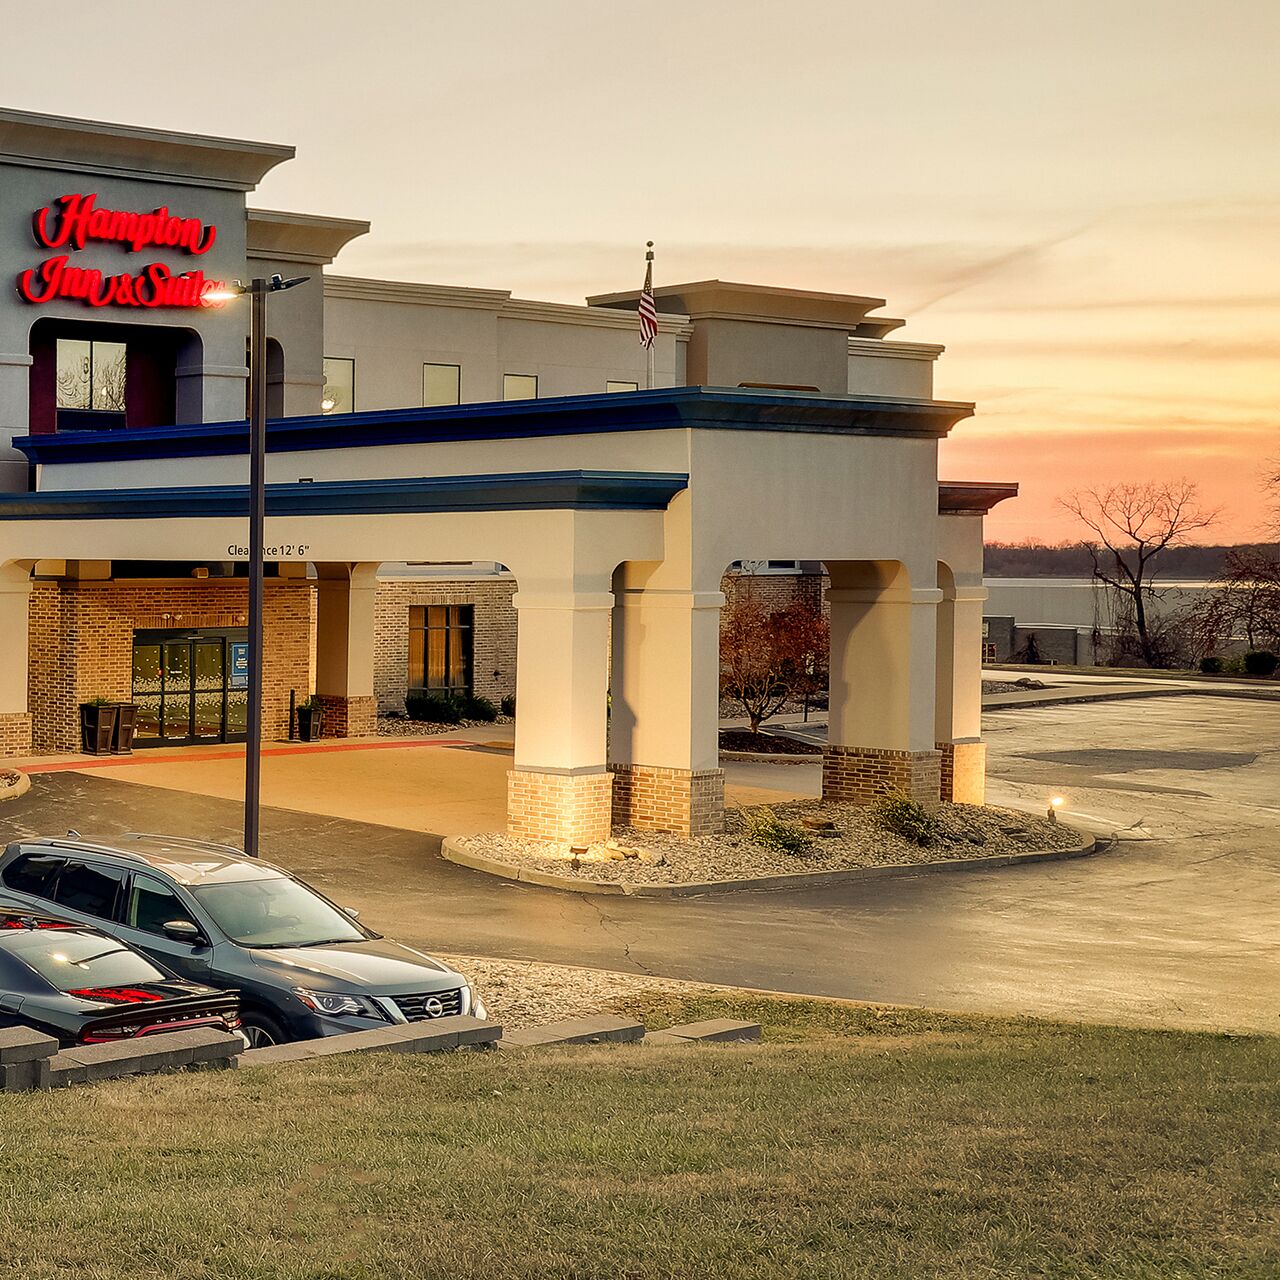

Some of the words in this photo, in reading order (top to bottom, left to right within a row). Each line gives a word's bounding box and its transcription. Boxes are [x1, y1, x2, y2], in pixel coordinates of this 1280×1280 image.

[33, 193, 216, 255] Hampton
[18, 255, 117, 308] Inn
[115, 272, 141, 306] &
